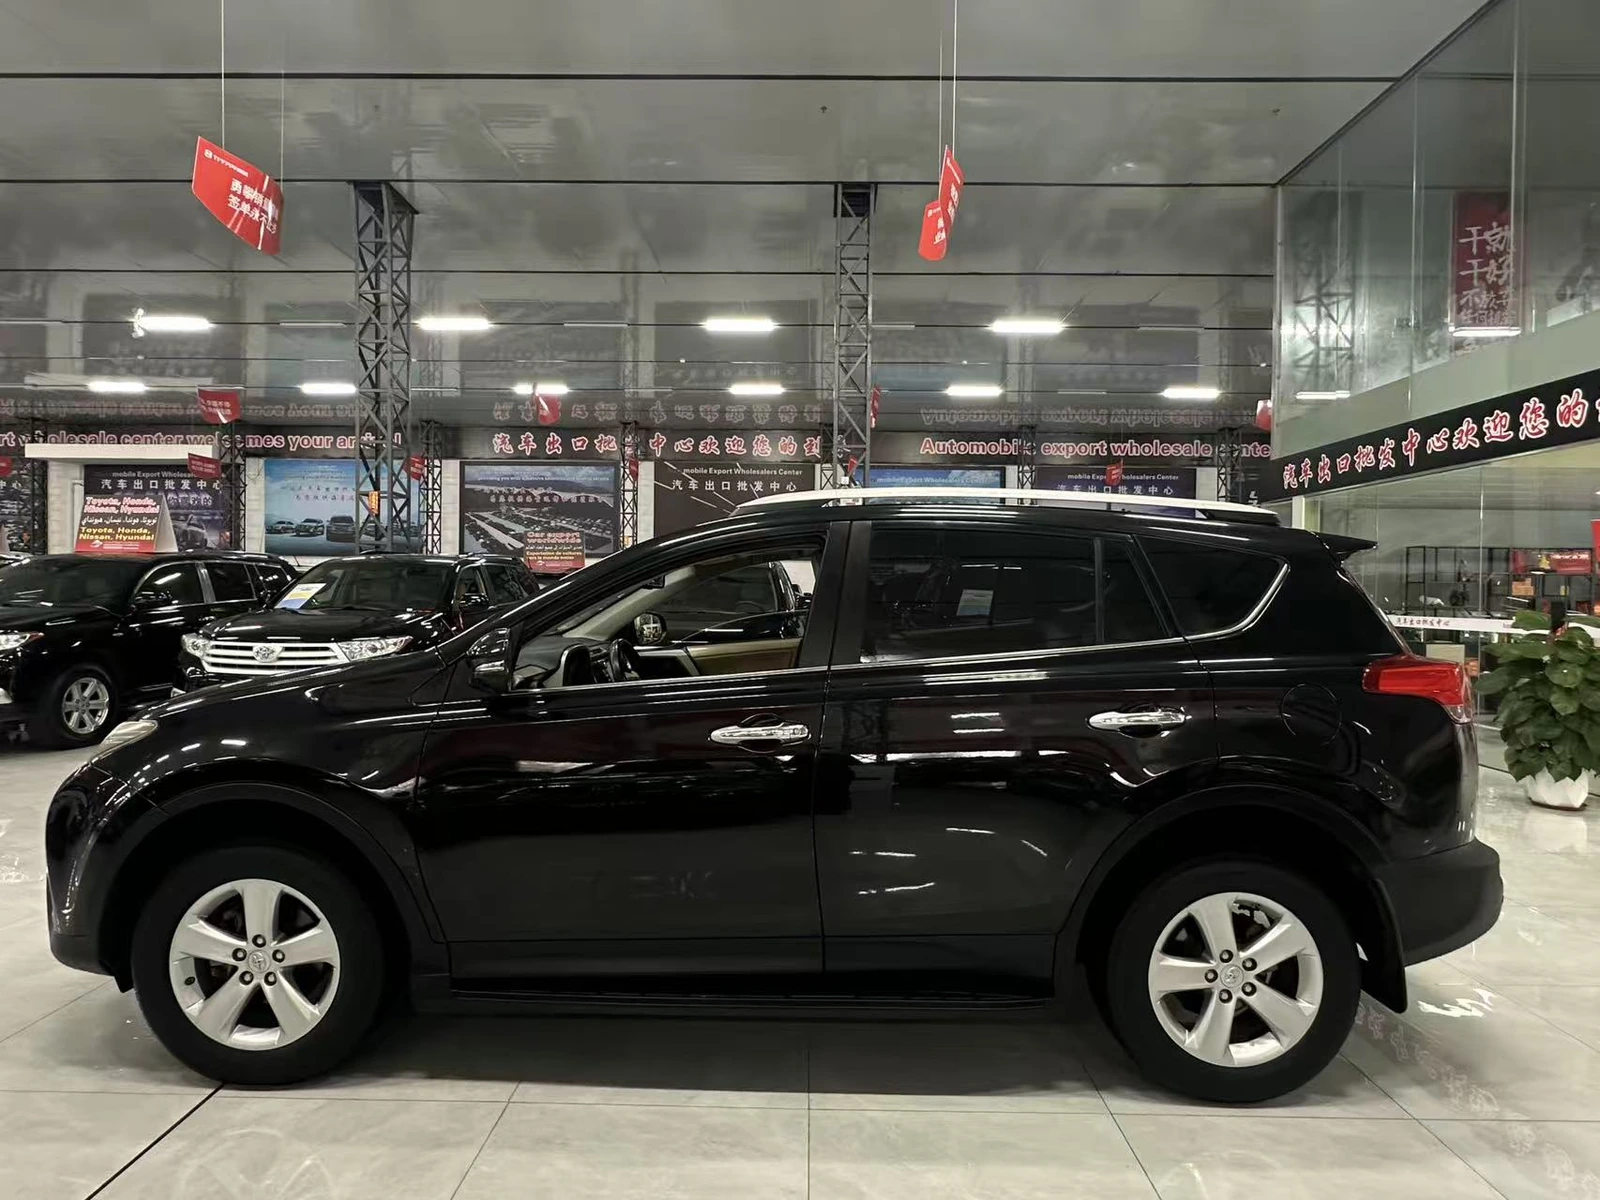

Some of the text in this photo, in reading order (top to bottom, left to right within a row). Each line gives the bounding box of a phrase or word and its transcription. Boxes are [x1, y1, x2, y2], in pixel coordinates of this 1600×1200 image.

[288, 435, 333, 451] your
[492, 431, 851, 459] 汽车出口批中心欢迎您的到
[1283, 388, 1600, 489] 汽车出口批发中心欢迎您的
[1041, 441, 1107, 458] export
[1110, 440, 1213, 457] wholesale
[137, 471, 160, 480] Export
[709, 467, 733, 476] Export
[778, 468, 803, 476] Center
[101, 479, 222, 490] 汽车出口批发中心
[672, 479, 797, 492] 汽车出口批发中心
